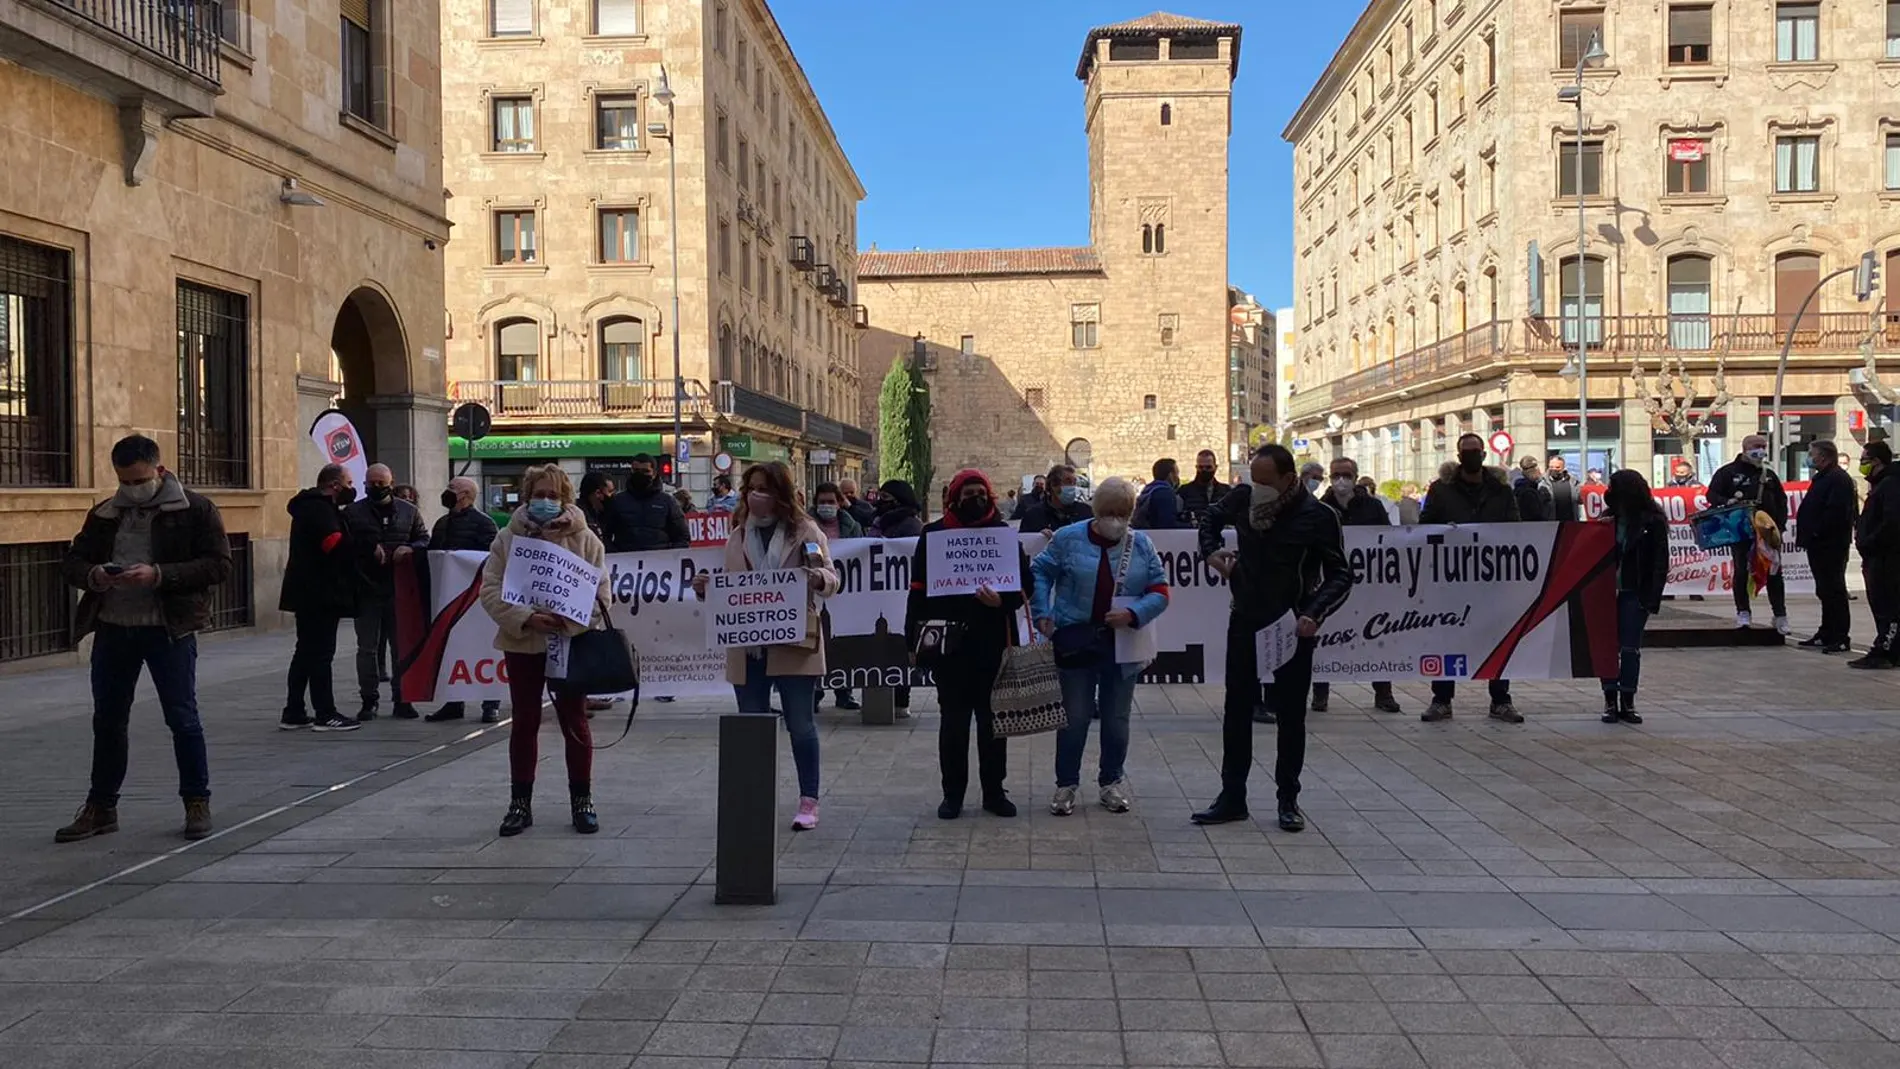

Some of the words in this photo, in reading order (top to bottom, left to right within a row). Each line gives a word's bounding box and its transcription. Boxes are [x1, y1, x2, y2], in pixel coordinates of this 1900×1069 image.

[499, 441, 509, 449] de
[512, 439, 538, 449] Salud
[540, 440, 572, 449] DKV
[727, 441, 747, 449] DKV
[688, 518, 705, 541] DE
[707, 516, 730, 541] SAL
[947, 537, 983, 547] HASTA
[985, 536, 999, 545] EL
[945, 549, 978, 560] MOÑO
[980, 549, 1001, 558] DEL
[514, 547, 598, 585] SOBREVIVIMOS
[610, 559, 671, 616] tejos
[835, 557, 862, 595] on
[869, 544, 910, 592] Em
[1350, 534, 1401, 584] ería
[1407, 547, 1422, 598] y
[1427, 532, 1539, 583] Turismo
[953, 563, 974, 573] 21%
[976, 562, 995, 572] IVA
[530, 564, 553, 577] POR
[557, 571, 579, 588] LOS
[714, 573, 734, 589] EL
[738, 572, 768, 587] 21%
[772, 570, 797, 585] IVA
[933, 579, 952, 590] ¡IVA
[955, 577, 969, 587] AL
[973, 576, 993, 586] 10%
[996, 575, 1014, 584] YA!
[531, 580, 570, 599] PELOS
[503, 591, 526, 605] ¡IVA
[529, 596, 542, 607] AL
[545, 599, 567, 612] 10%
[570, 606, 587, 622] YA!
[728, 591, 785, 607] CIERRA
[715, 608, 798, 627] NUESTROS
[1363, 604, 1471, 640] Cultura!
[717, 627, 797, 646] NEGOCIOS
[641, 653, 690, 663] ASOCIACIÓN
[693, 651, 726, 661] ESPAÑO
[654, 663, 693, 672] AGENCIAS
[702, 663, 726, 671] PROF
[641, 675, 657, 683] DEL
